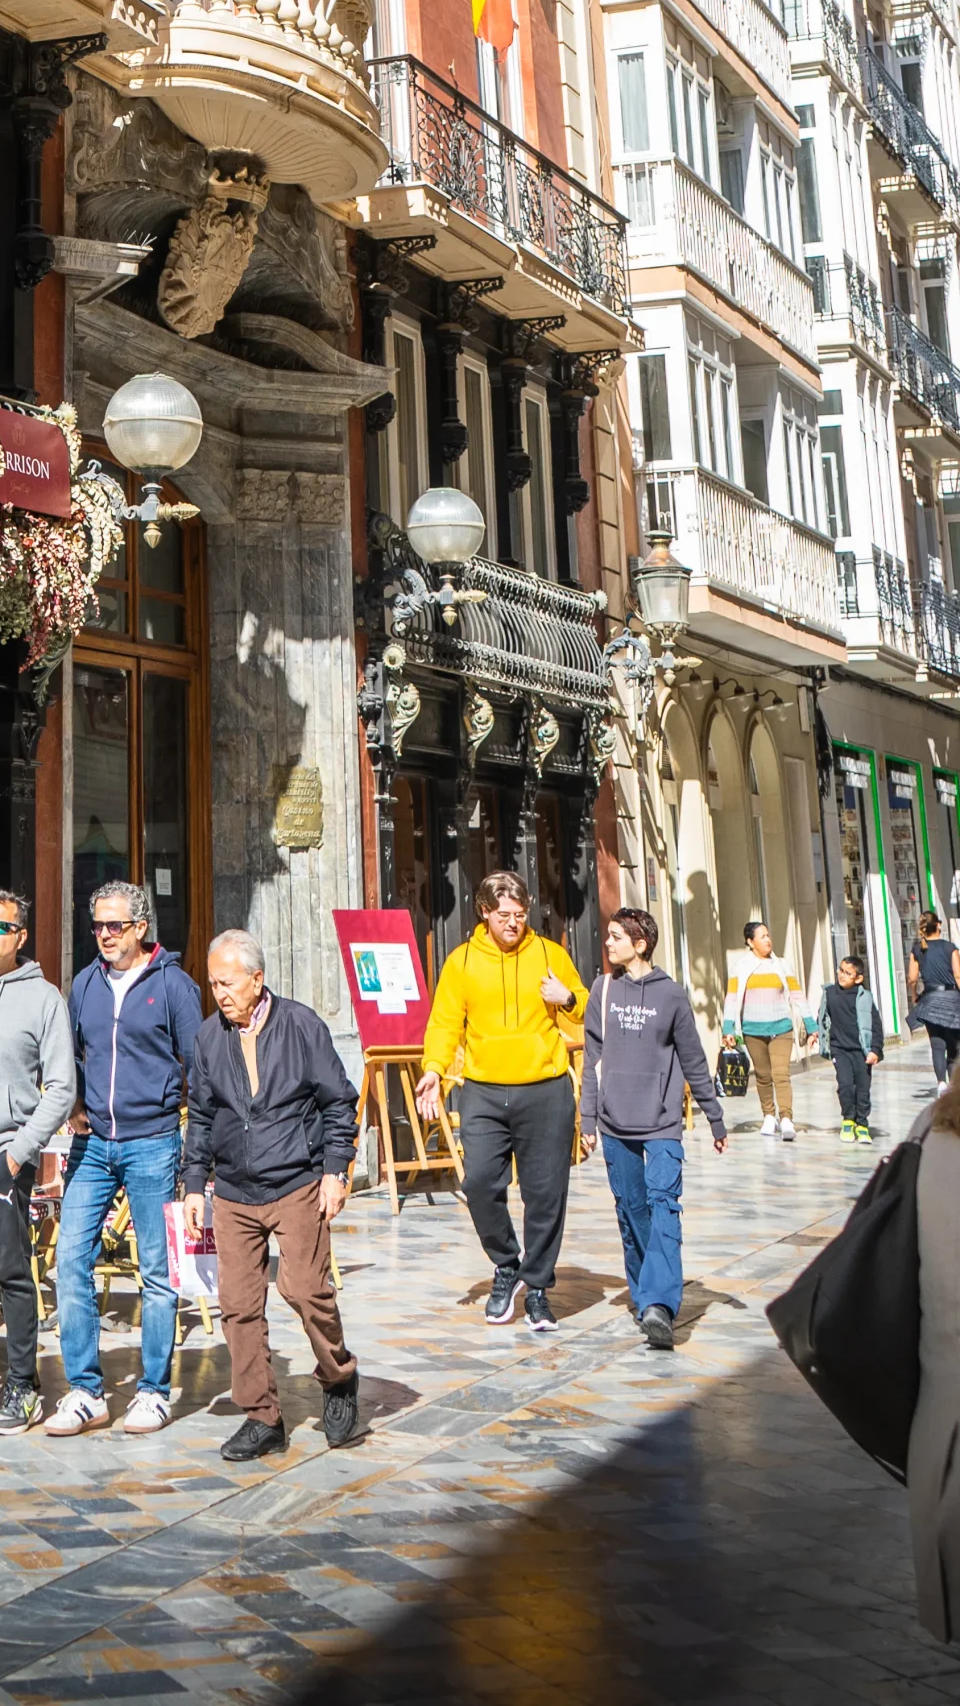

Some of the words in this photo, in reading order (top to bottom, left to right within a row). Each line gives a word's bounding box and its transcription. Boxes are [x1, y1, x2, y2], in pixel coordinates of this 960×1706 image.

[6, 451, 49, 480] RRISON
[282, 805, 314, 816] Casino
[293, 818, 305, 826] de
[276, 827, 321, 840] Cartagena
